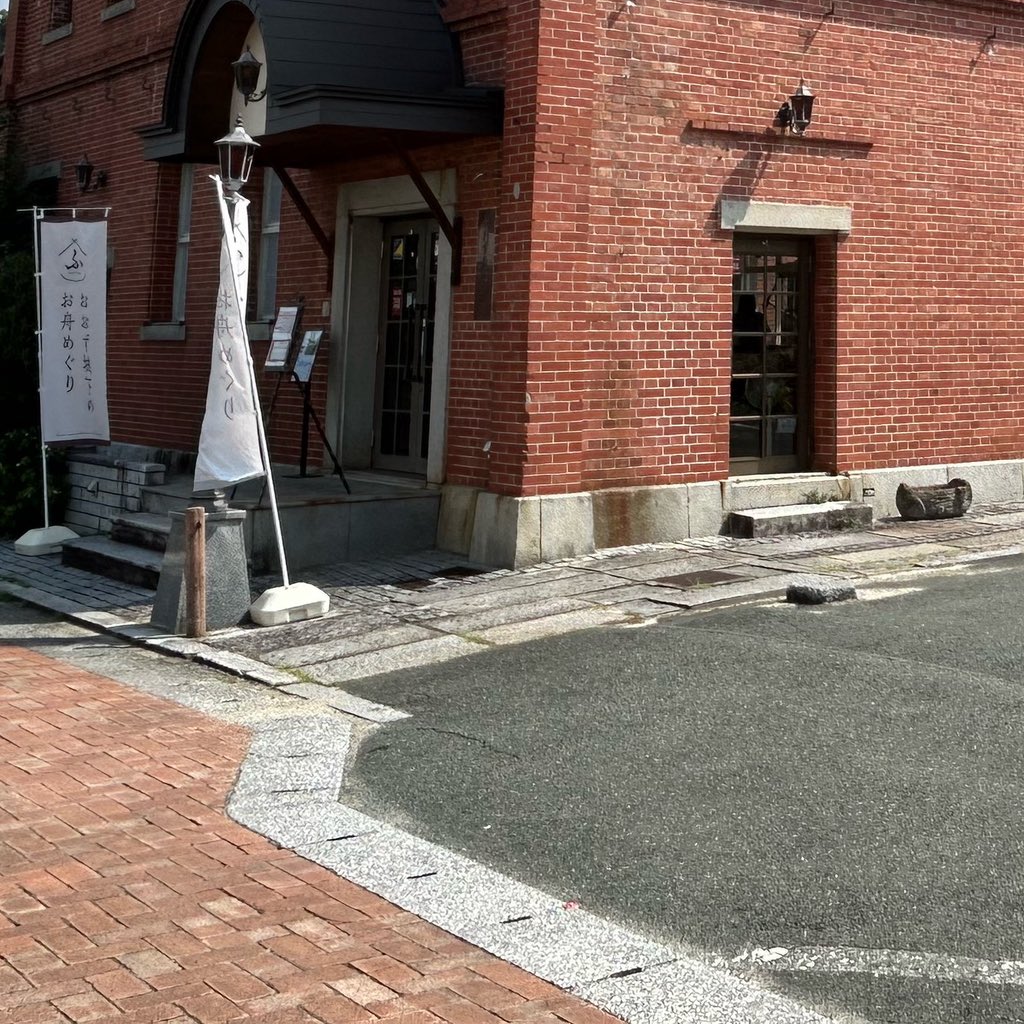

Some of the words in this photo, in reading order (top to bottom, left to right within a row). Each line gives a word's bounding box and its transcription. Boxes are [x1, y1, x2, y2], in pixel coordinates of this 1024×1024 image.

[61, 292, 75, 393] お舟めぐり
